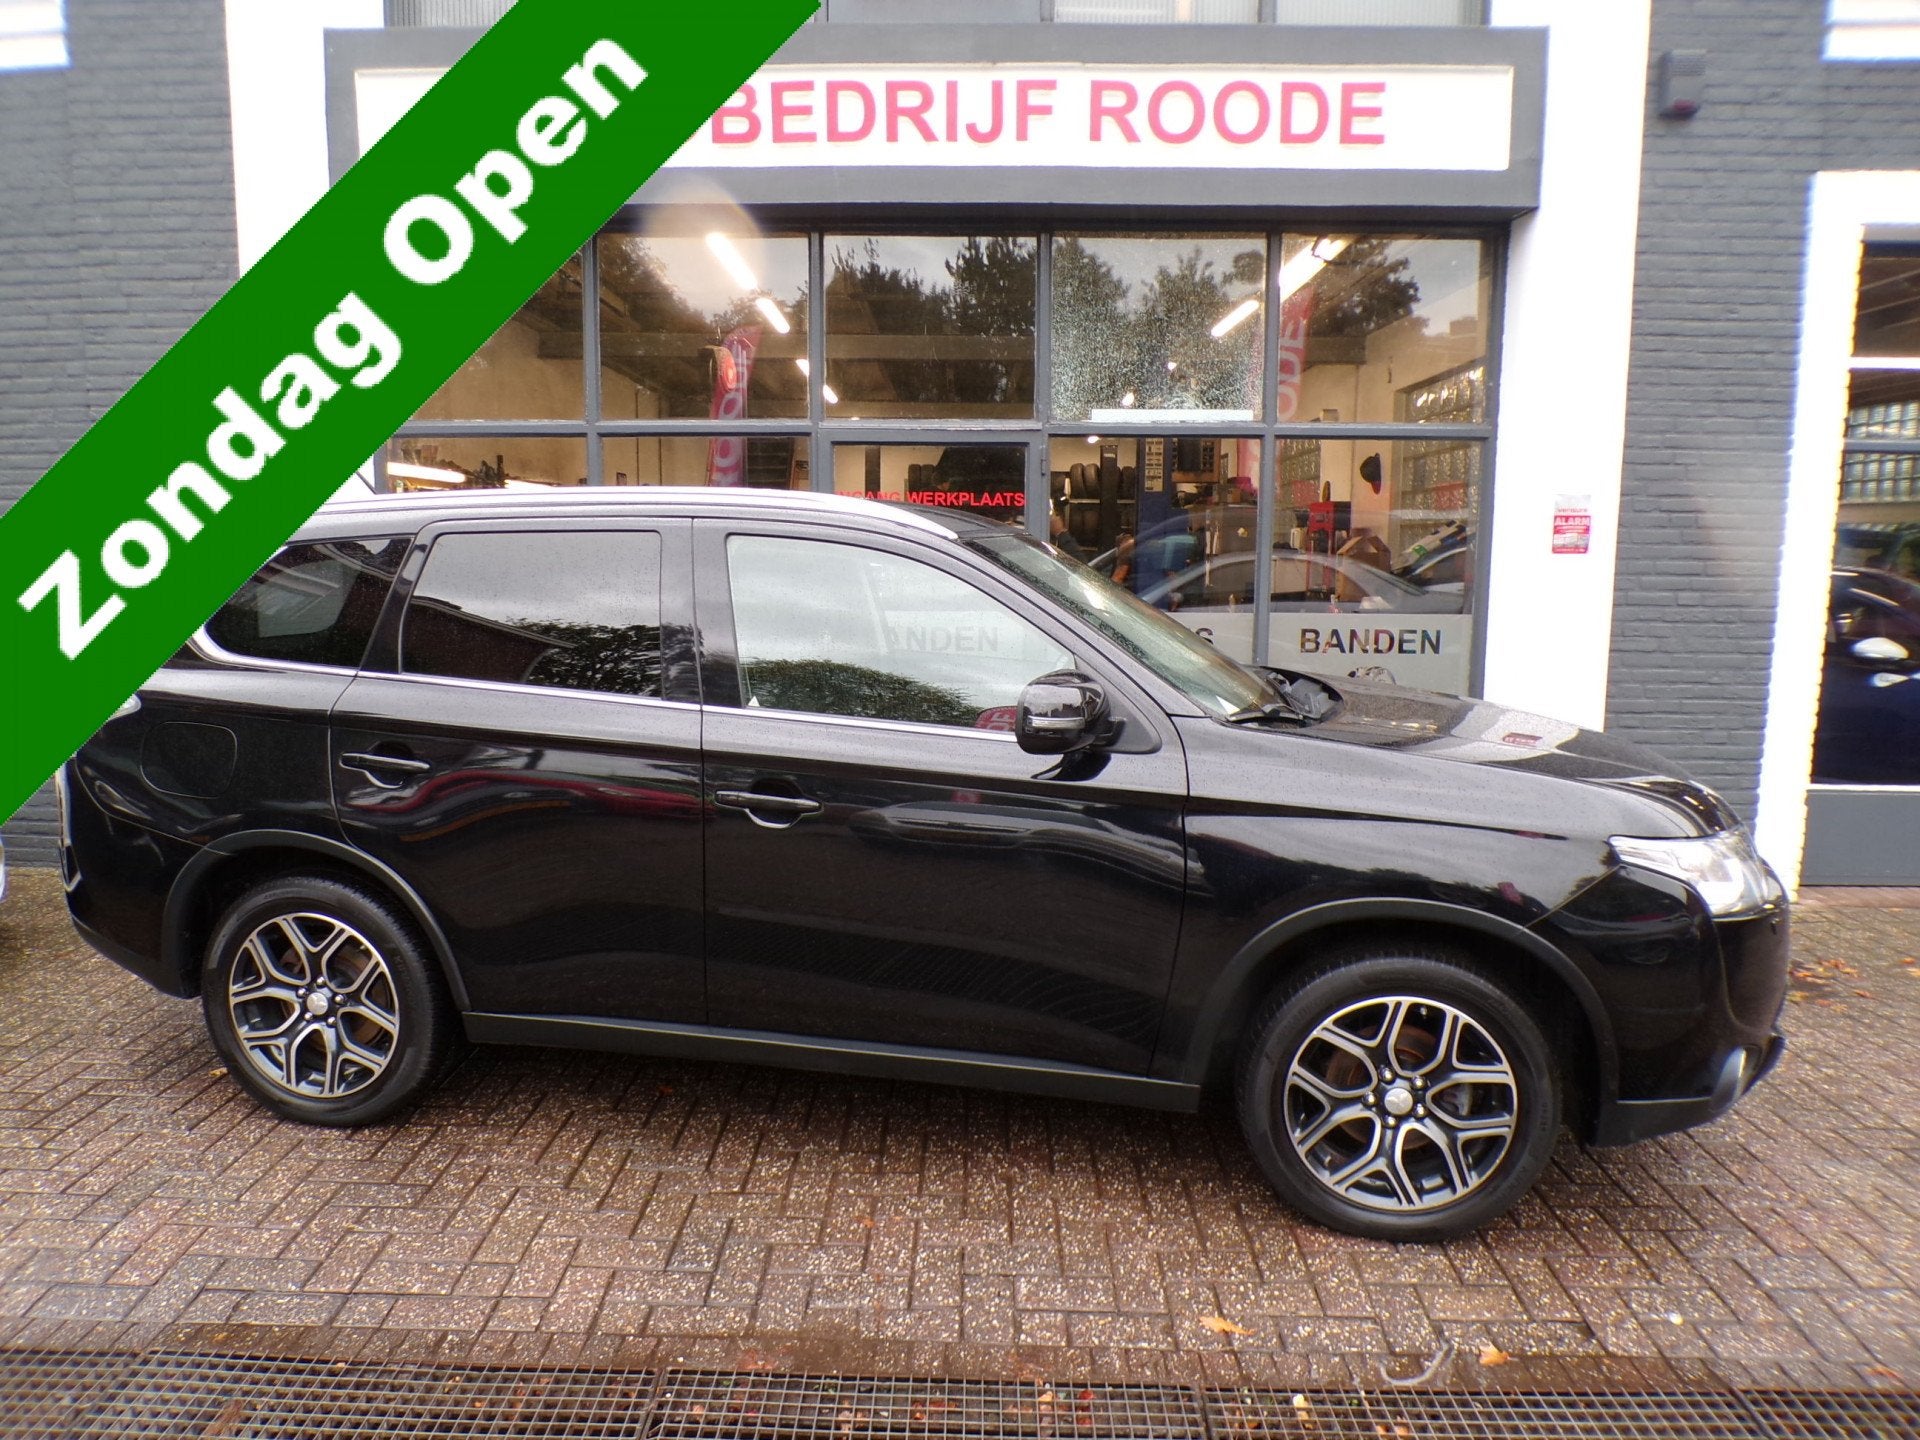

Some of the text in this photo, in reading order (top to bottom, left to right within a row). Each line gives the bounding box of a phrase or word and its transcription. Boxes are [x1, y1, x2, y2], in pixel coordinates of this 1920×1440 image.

[711, 79, 1385, 144] BEDRIJF ROODE
[907, 492, 1025, 507] WERKPLAATS
[1554, 516, 1590, 526] ALARM
[1300, 628, 1441, 655] BANDEN
